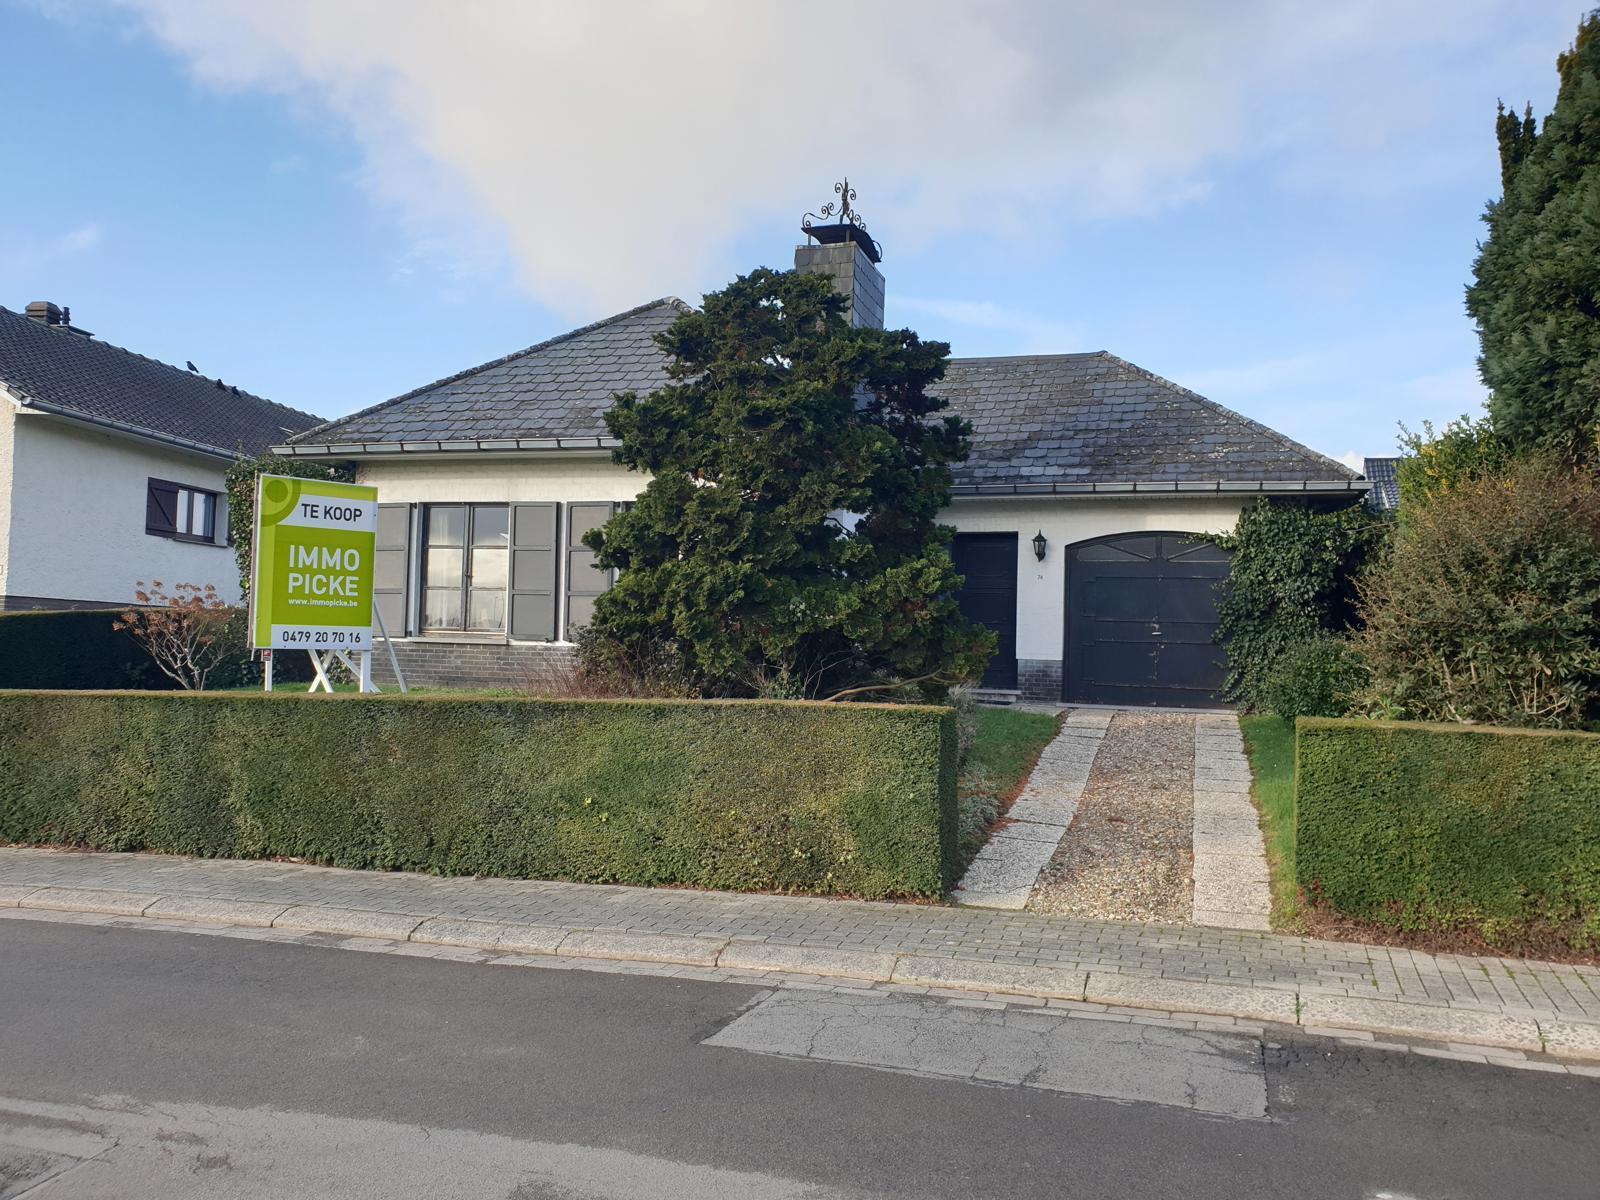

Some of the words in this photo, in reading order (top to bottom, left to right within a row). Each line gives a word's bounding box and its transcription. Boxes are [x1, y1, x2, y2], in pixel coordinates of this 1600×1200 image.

[301, 503, 319, 518] TE
[323, 505, 363, 522] KOOP
[289, 544, 360, 571] IMMO
[288, 572, 359, 597] PICKE
[288, 598, 358, 608] www.immopicke.be
[283, 630, 311, 643] 0479
[315, 630, 329, 643] 20
[332, 631, 345, 643] 70
[349, 631, 361, 643] 16
